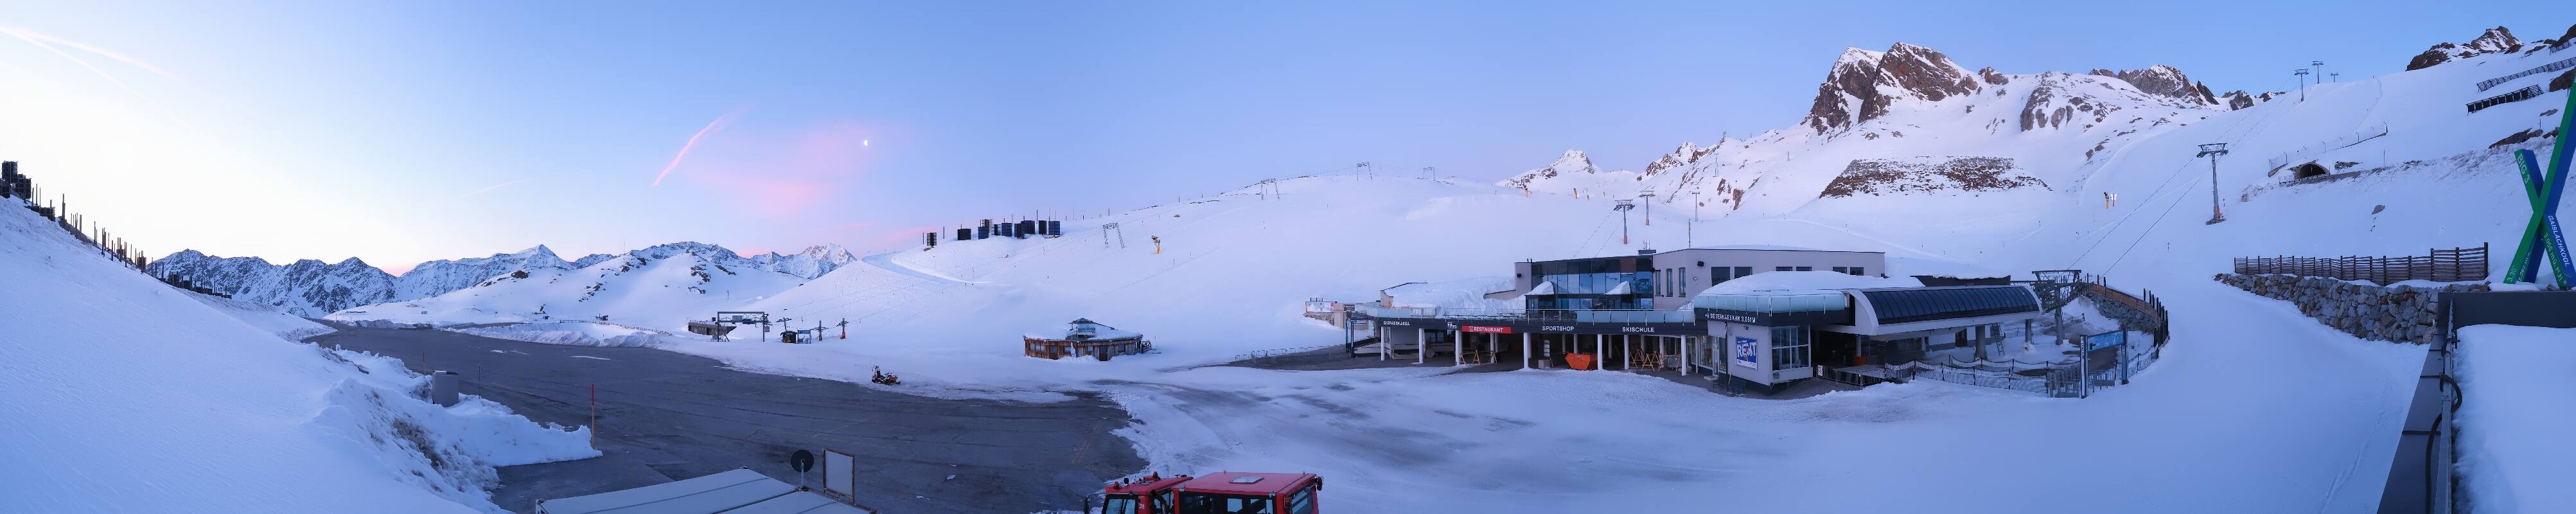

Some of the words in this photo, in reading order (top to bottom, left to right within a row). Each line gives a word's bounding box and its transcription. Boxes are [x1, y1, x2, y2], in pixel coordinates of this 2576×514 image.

[2518, 154, 2527, 174] BIG
[2525, 175, 2530, 184] 3
[2548, 215, 2570, 267] GAISLACHKOGL
